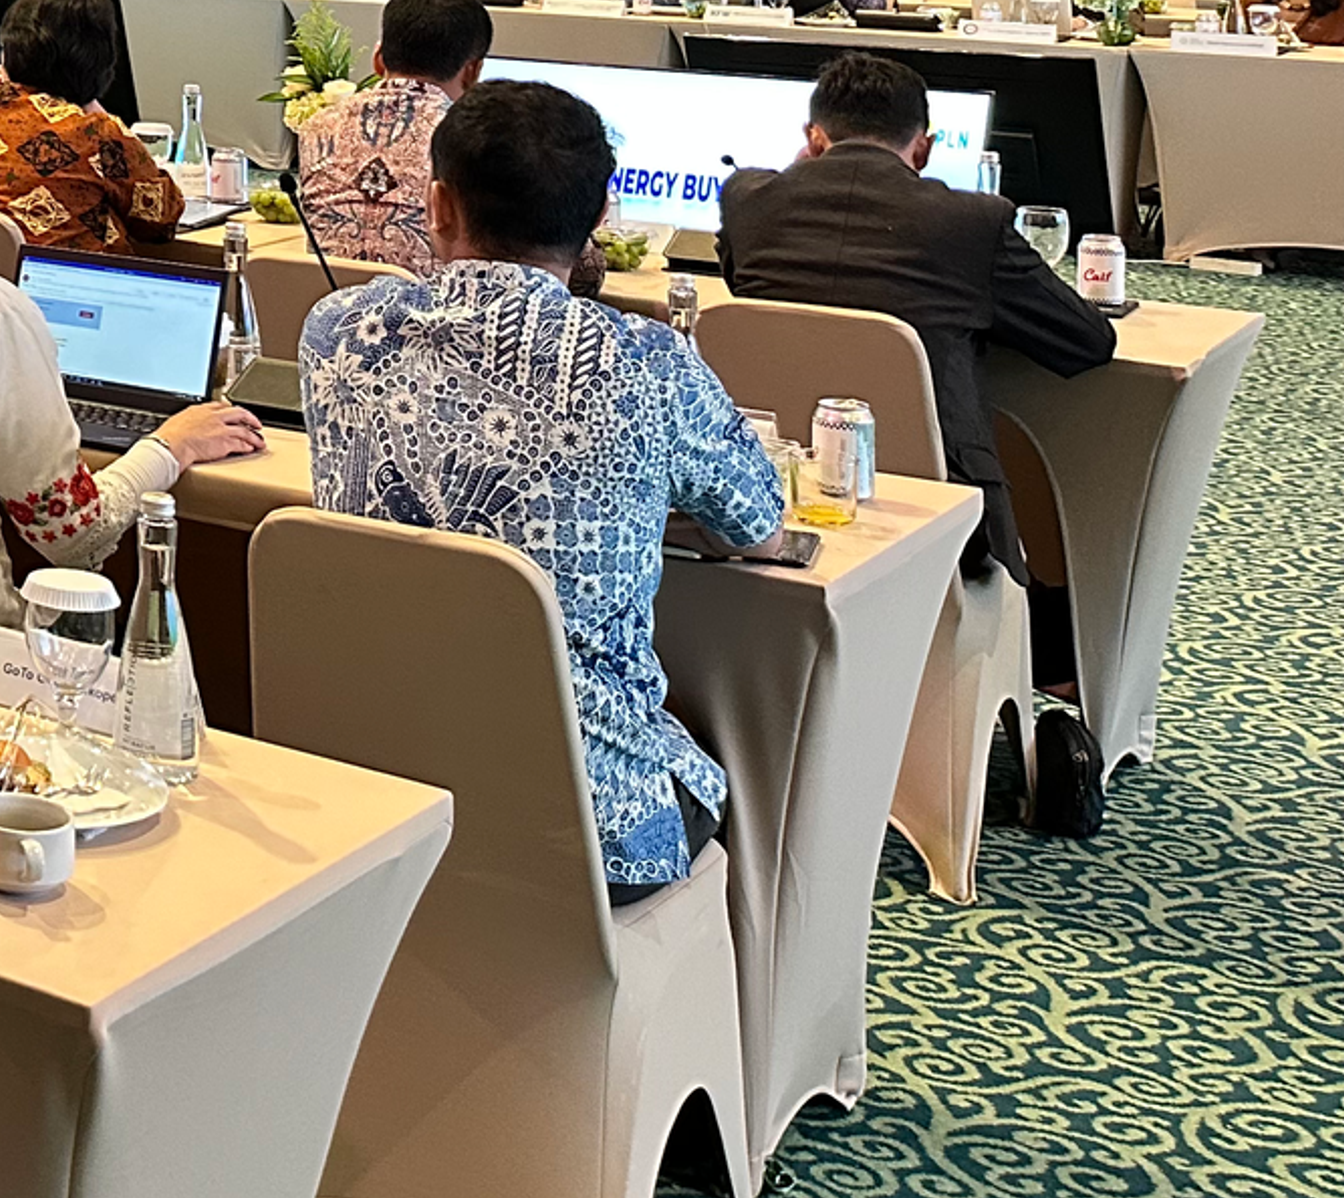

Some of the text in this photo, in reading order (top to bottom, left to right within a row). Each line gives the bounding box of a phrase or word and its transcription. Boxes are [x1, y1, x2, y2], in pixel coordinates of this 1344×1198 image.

[936, 129, 969, 150] PLN
[608, 167, 679, 199] NERGY
[3, 662, 35, 681] GoTo
